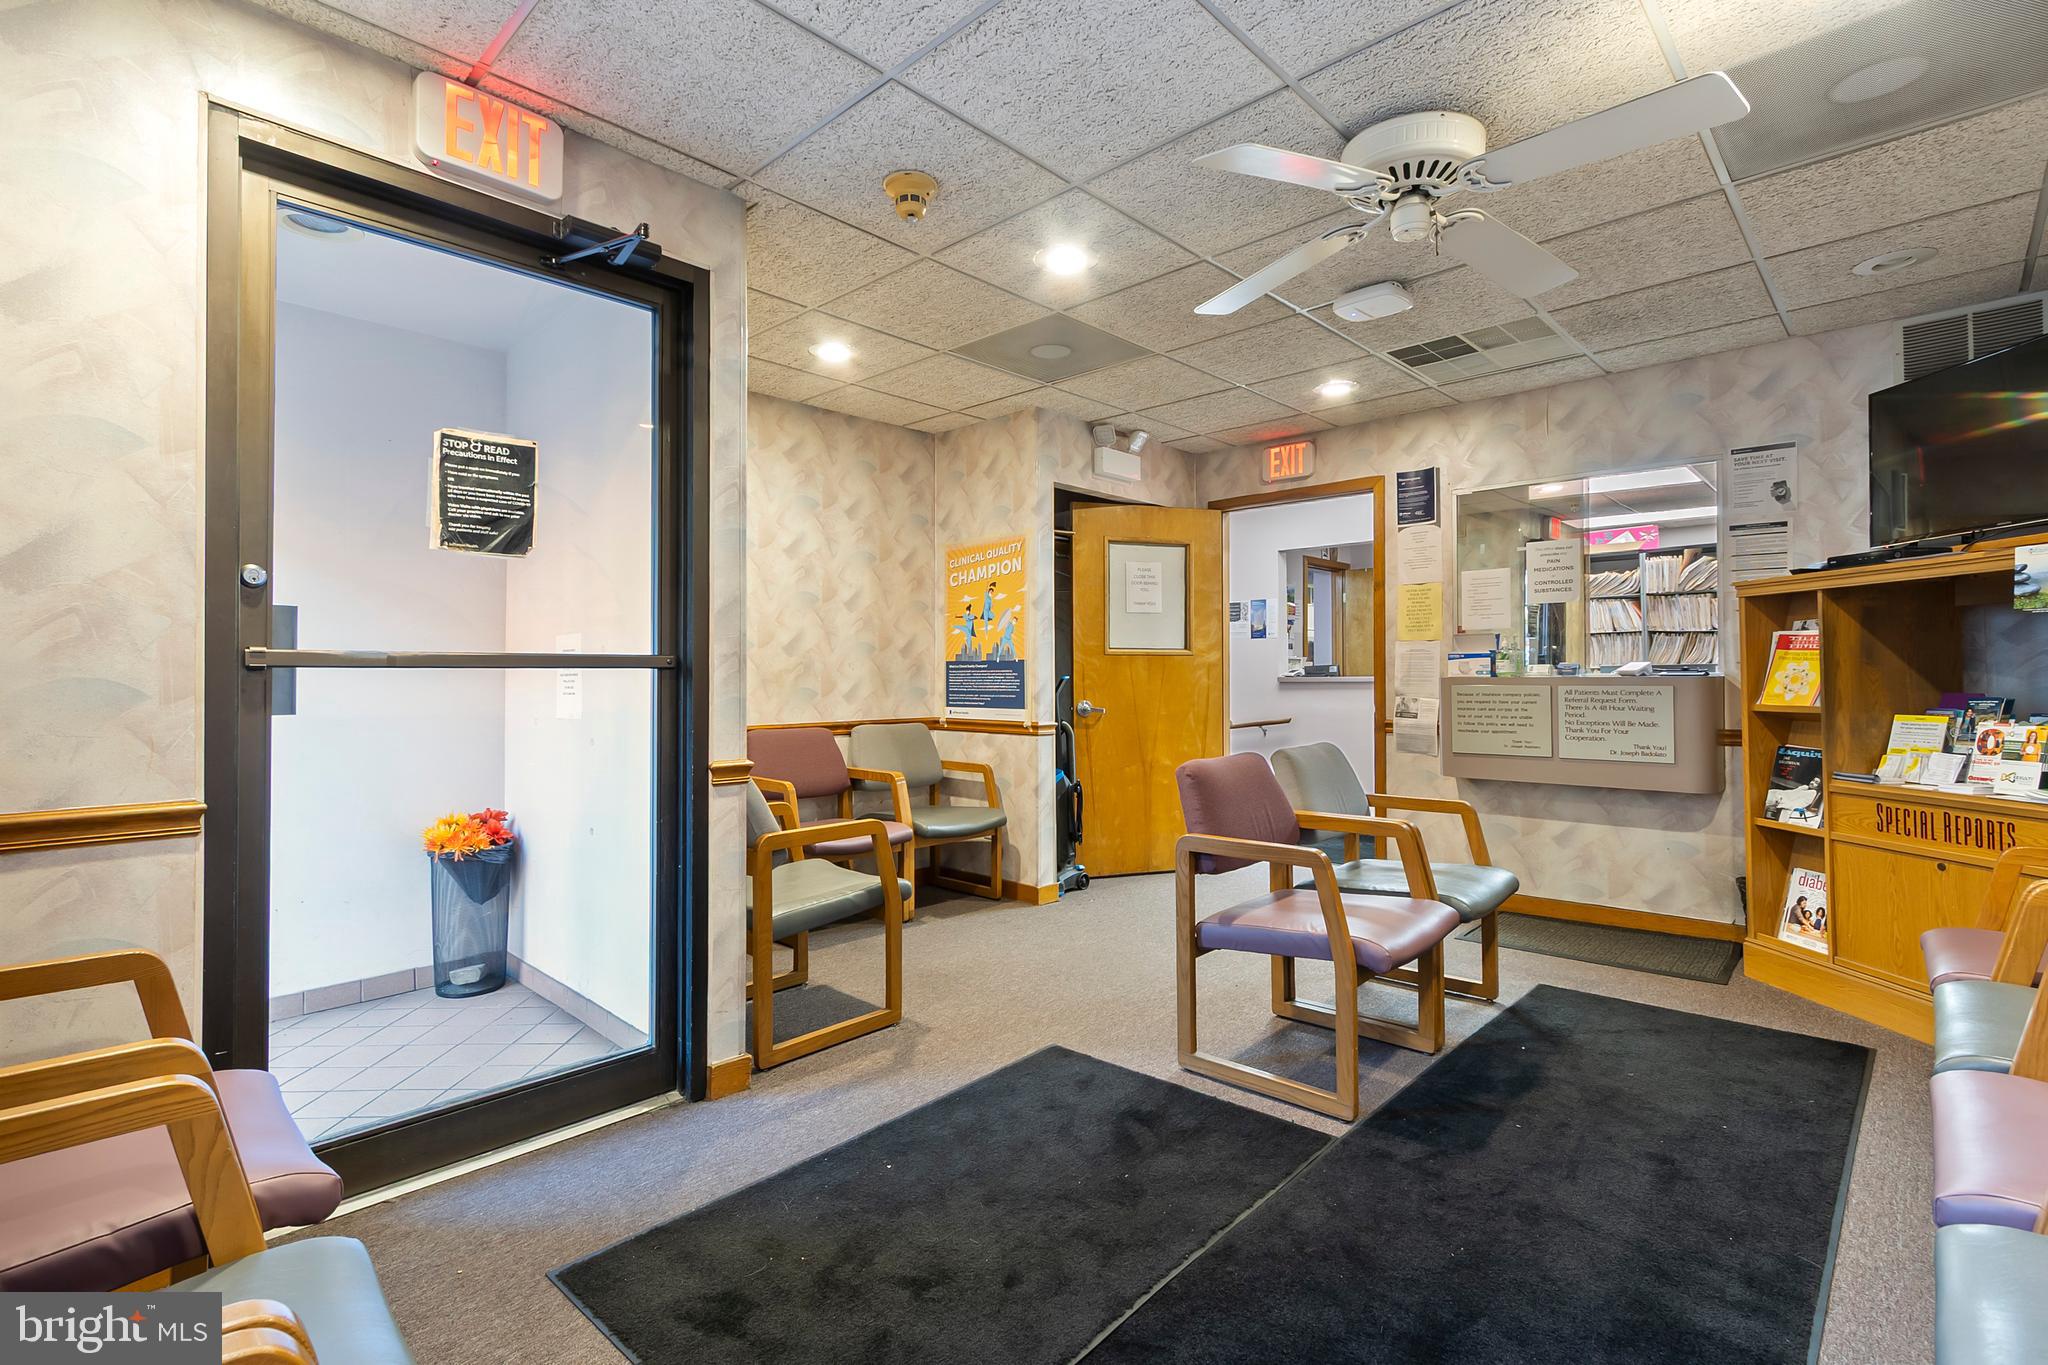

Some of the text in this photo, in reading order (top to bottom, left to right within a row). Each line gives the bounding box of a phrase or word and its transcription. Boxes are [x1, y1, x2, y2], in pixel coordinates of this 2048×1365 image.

[445, 80, 548, 188] EXIT
[442, 438, 468, 450] STOP
[484, 445, 510, 455] READ
[442, 447, 486, 460] Precautions
[496, 456, 518, 465] Effect
[1270, 443, 1306, 478] EXIT
[950, 541, 1023, 569] CLINICAL QUALITY
[950, 556, 1023, 588] CHAMPION
[1876, 803, 1937, 841] SPECIAL
